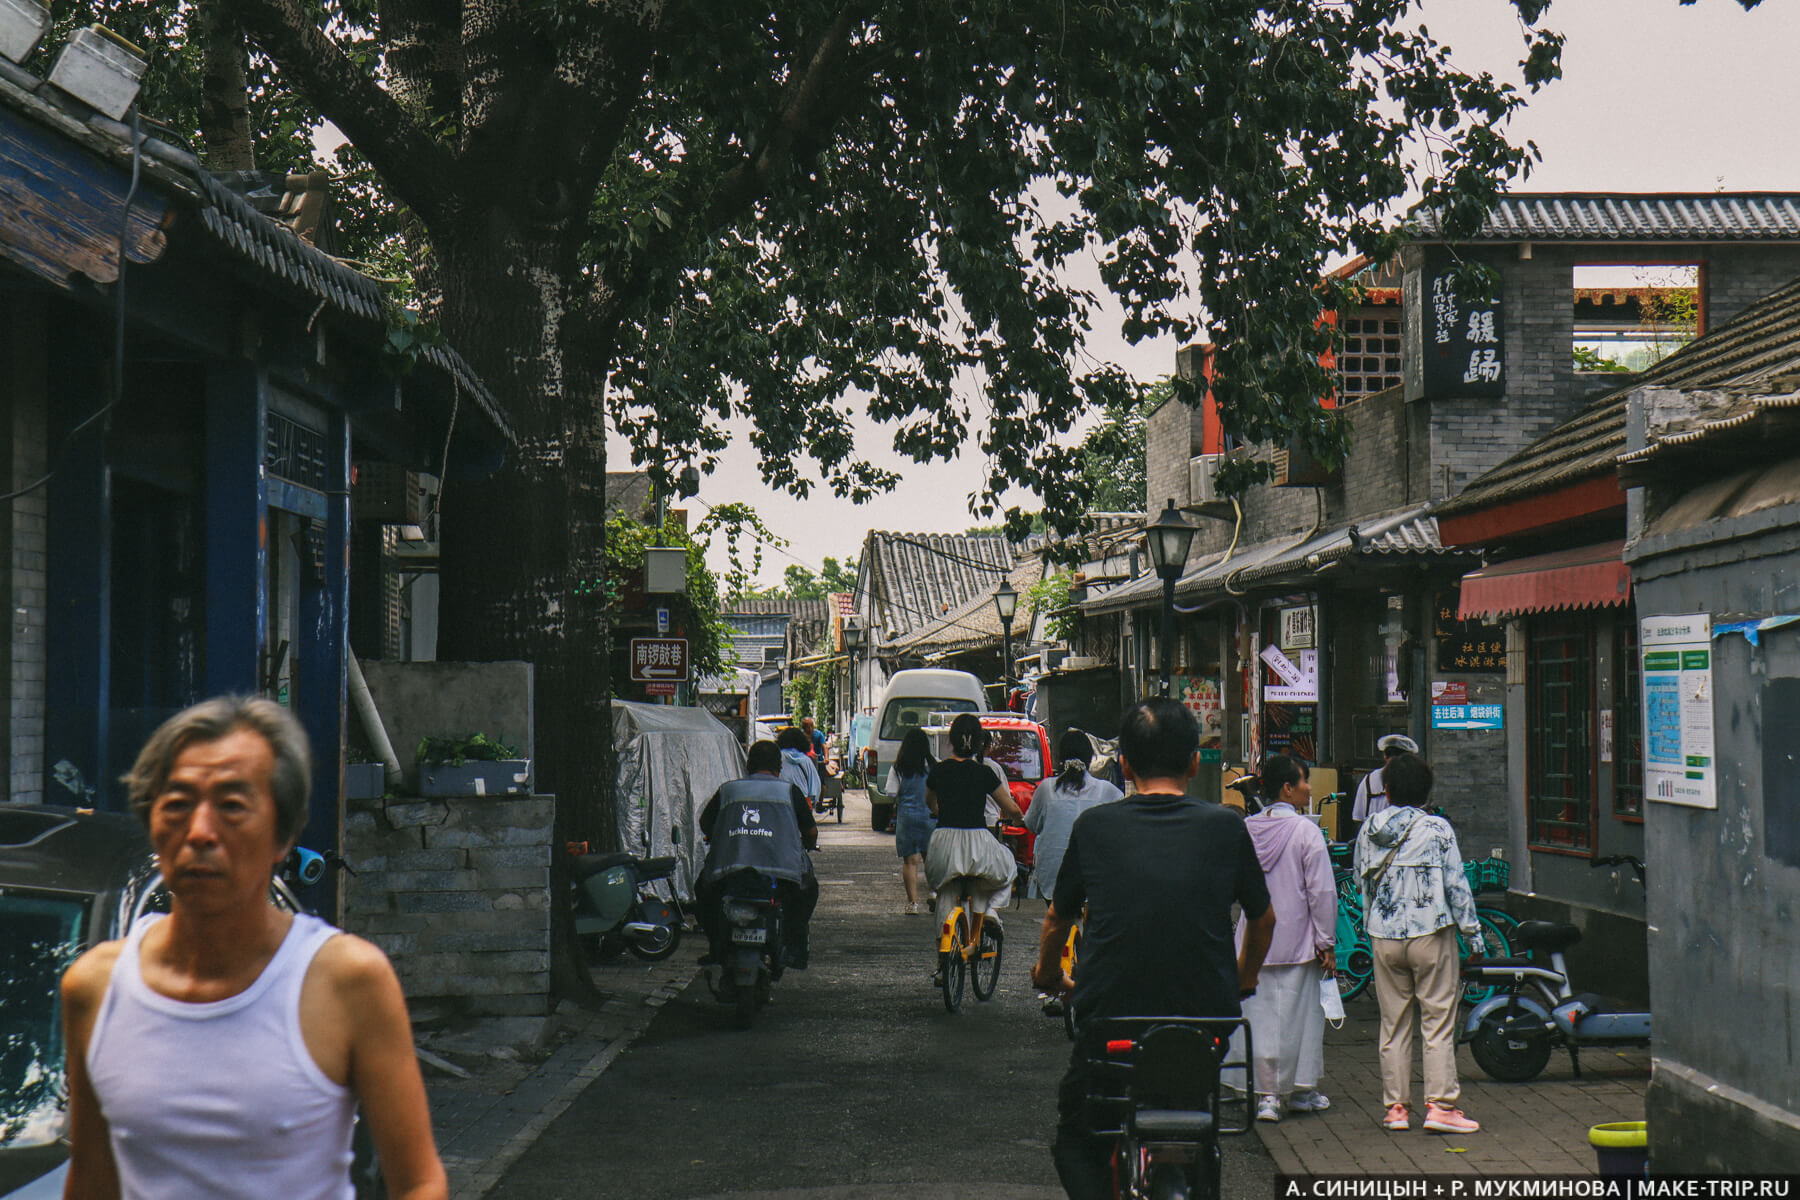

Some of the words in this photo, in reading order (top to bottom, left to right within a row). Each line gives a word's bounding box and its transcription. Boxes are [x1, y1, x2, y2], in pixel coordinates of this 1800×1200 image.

[636, 643, 682, 666] 南锣鼓巷
[1434, 706, 1465, 719] 去往后海
[1469, 706, 1501, 719] 烟袋斜街
[749, 827, 773, 838] coffee
